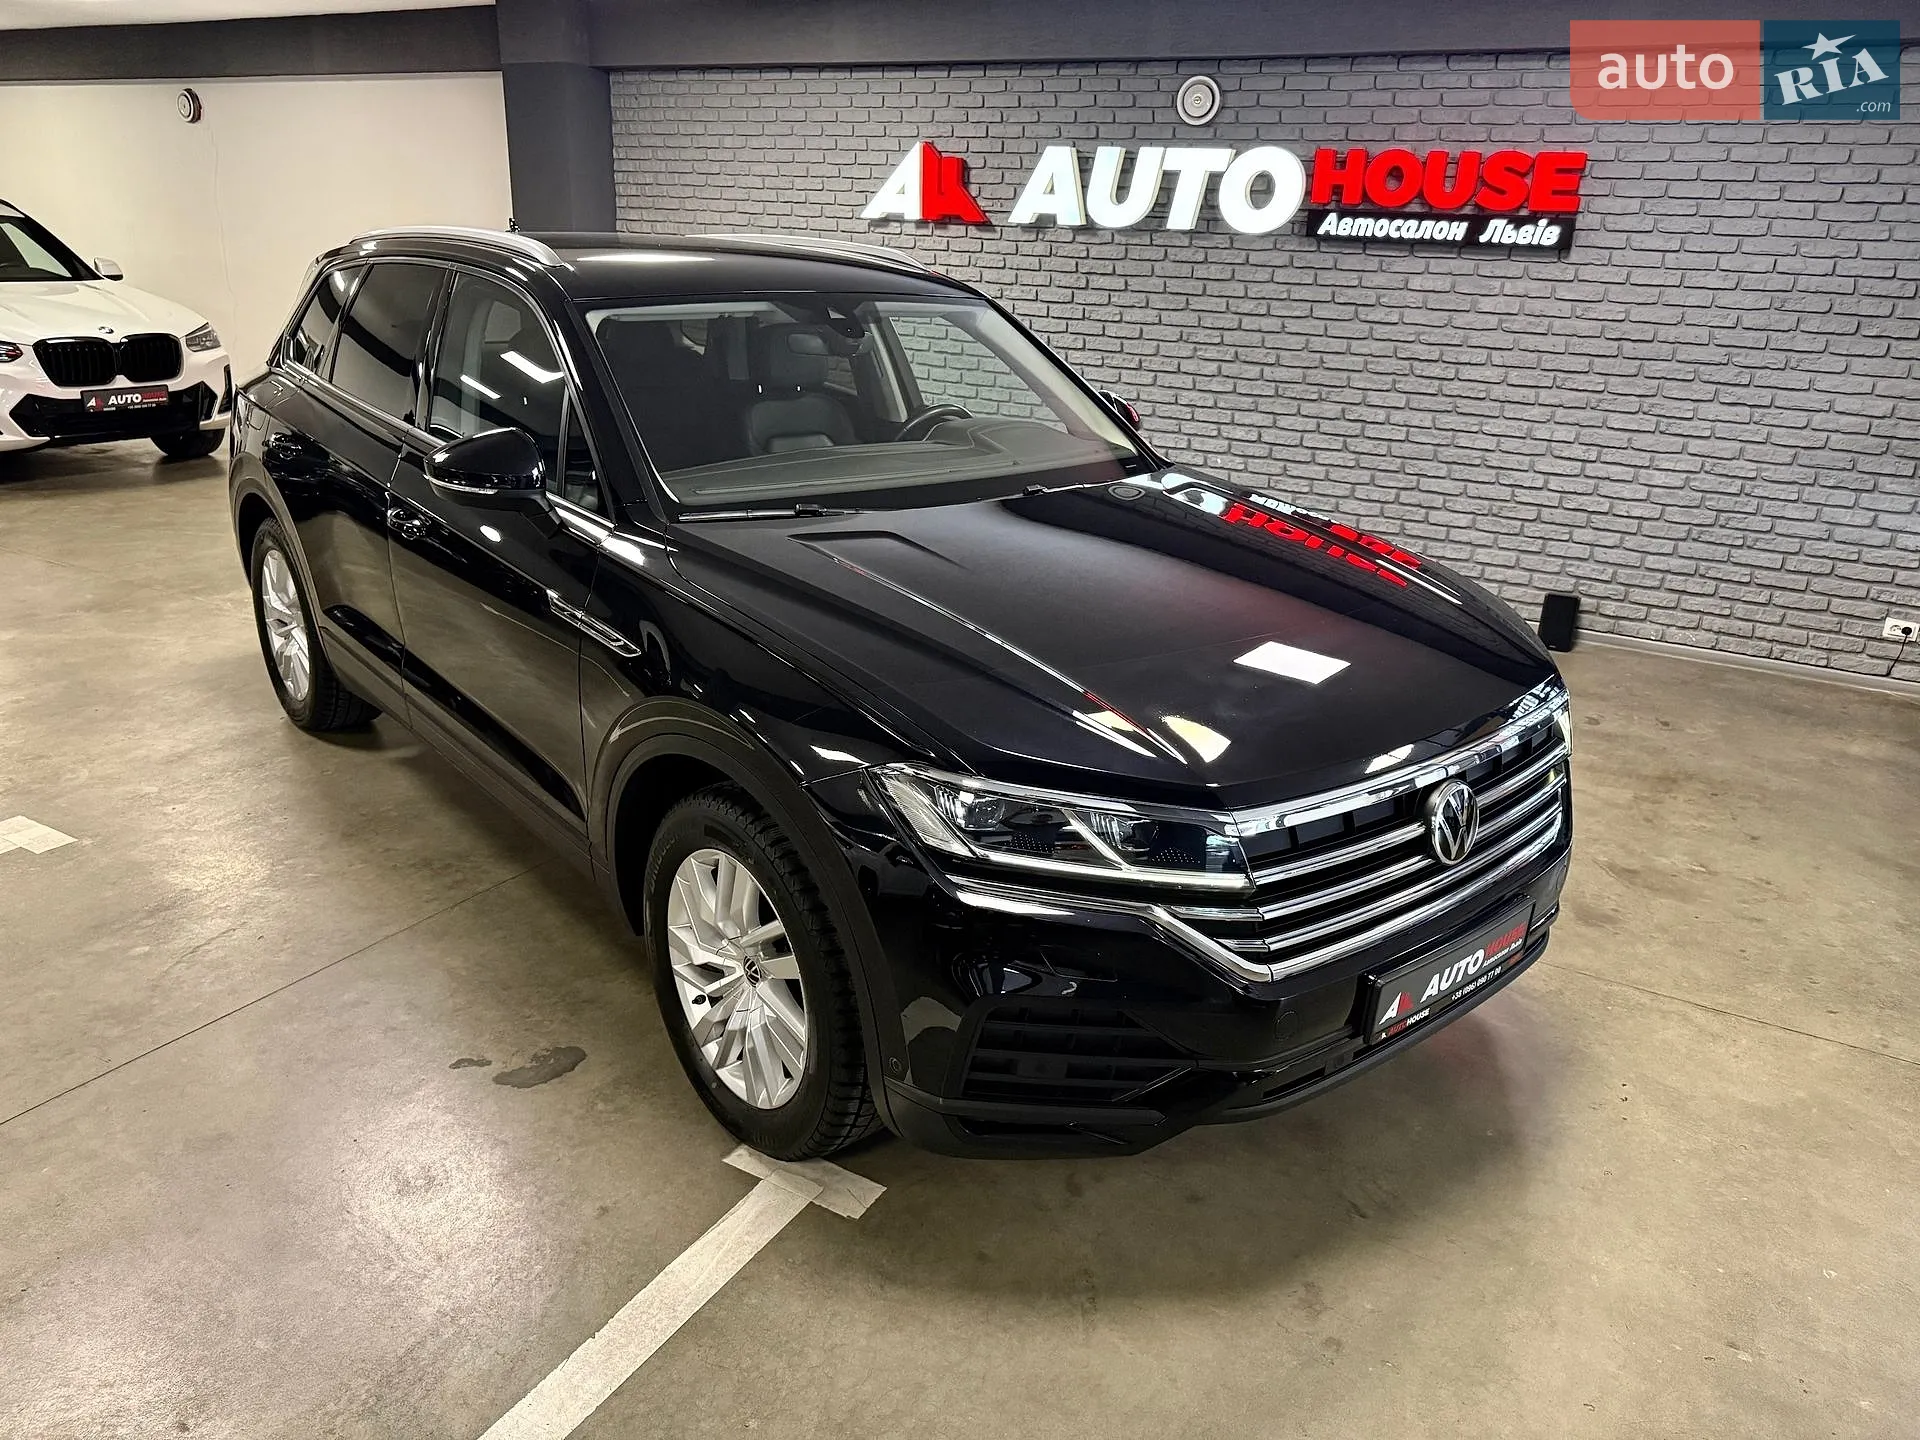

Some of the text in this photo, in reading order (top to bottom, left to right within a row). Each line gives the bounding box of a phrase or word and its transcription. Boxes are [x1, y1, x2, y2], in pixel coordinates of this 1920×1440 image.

[1007, 145, 1588, 234] AUTO HOUSE
[1317, 212, 1561, 246] Автосалон Львів
[108, 394, 142, 405] AUTO
[1420, 949, 1485, 1003] AUTO
